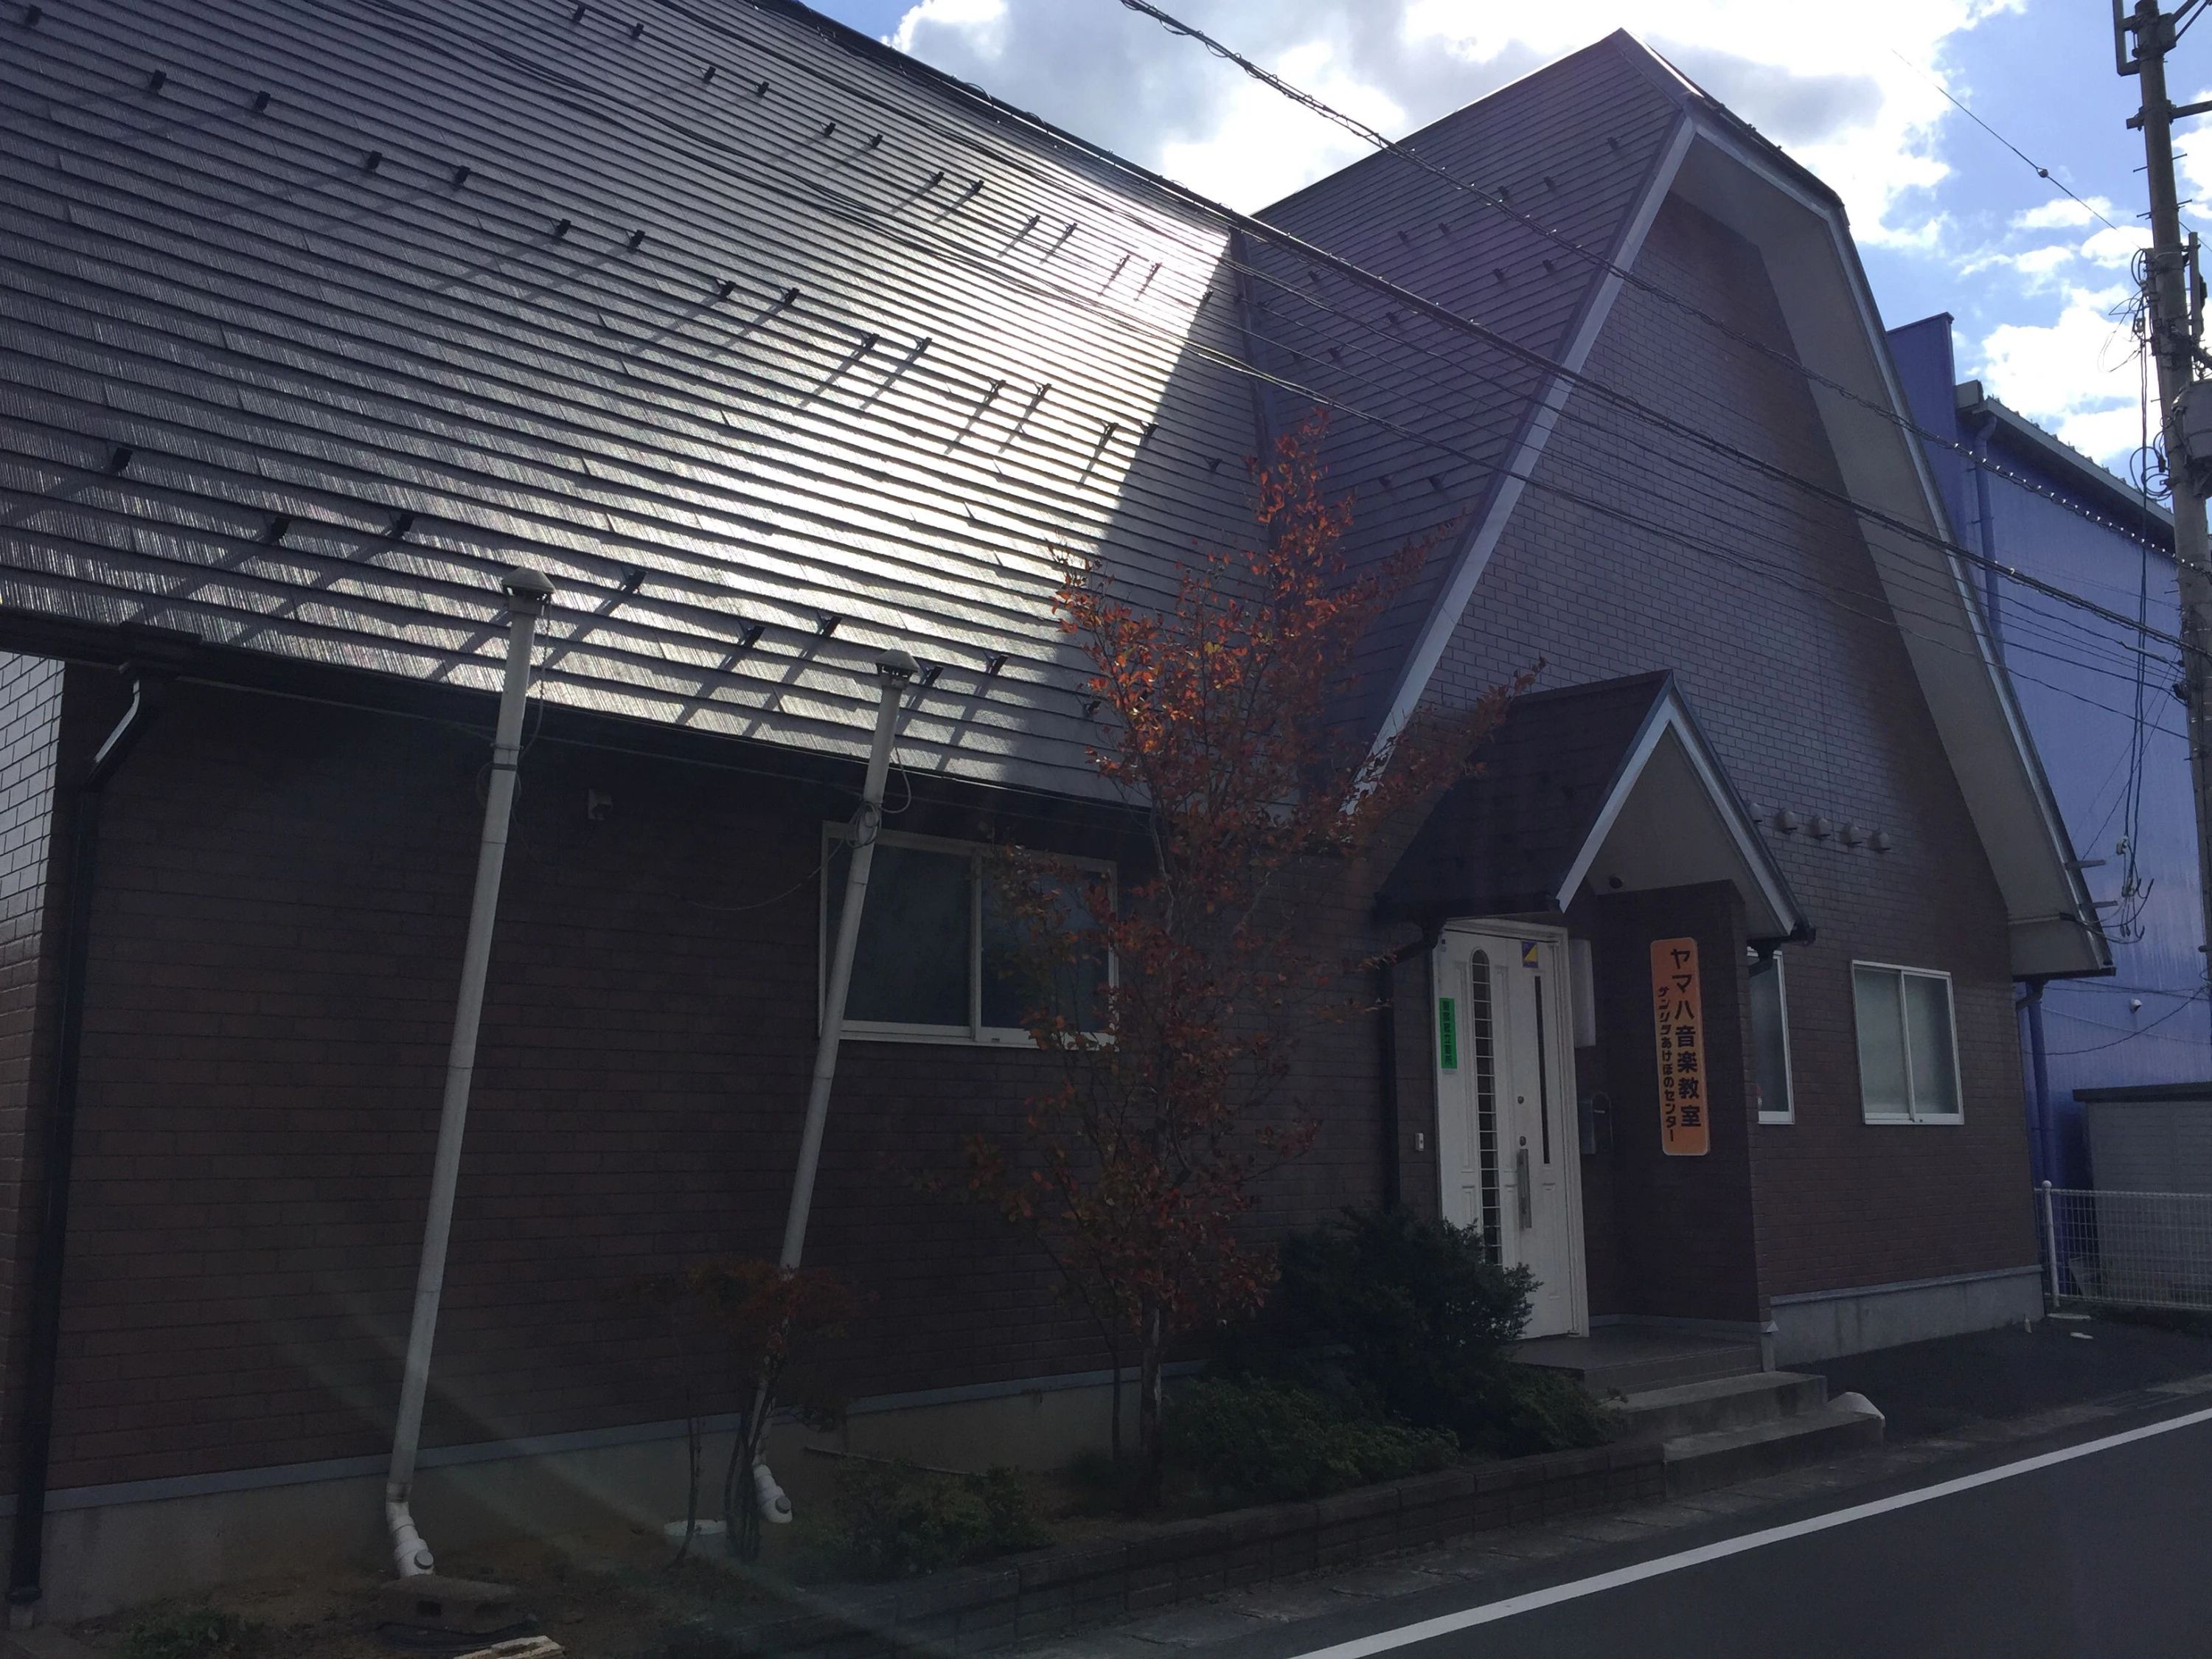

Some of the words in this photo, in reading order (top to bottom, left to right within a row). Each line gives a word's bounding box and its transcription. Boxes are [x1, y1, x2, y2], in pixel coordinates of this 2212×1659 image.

[1670, 948, 1702, 1128] ヤマハ音楽教室
